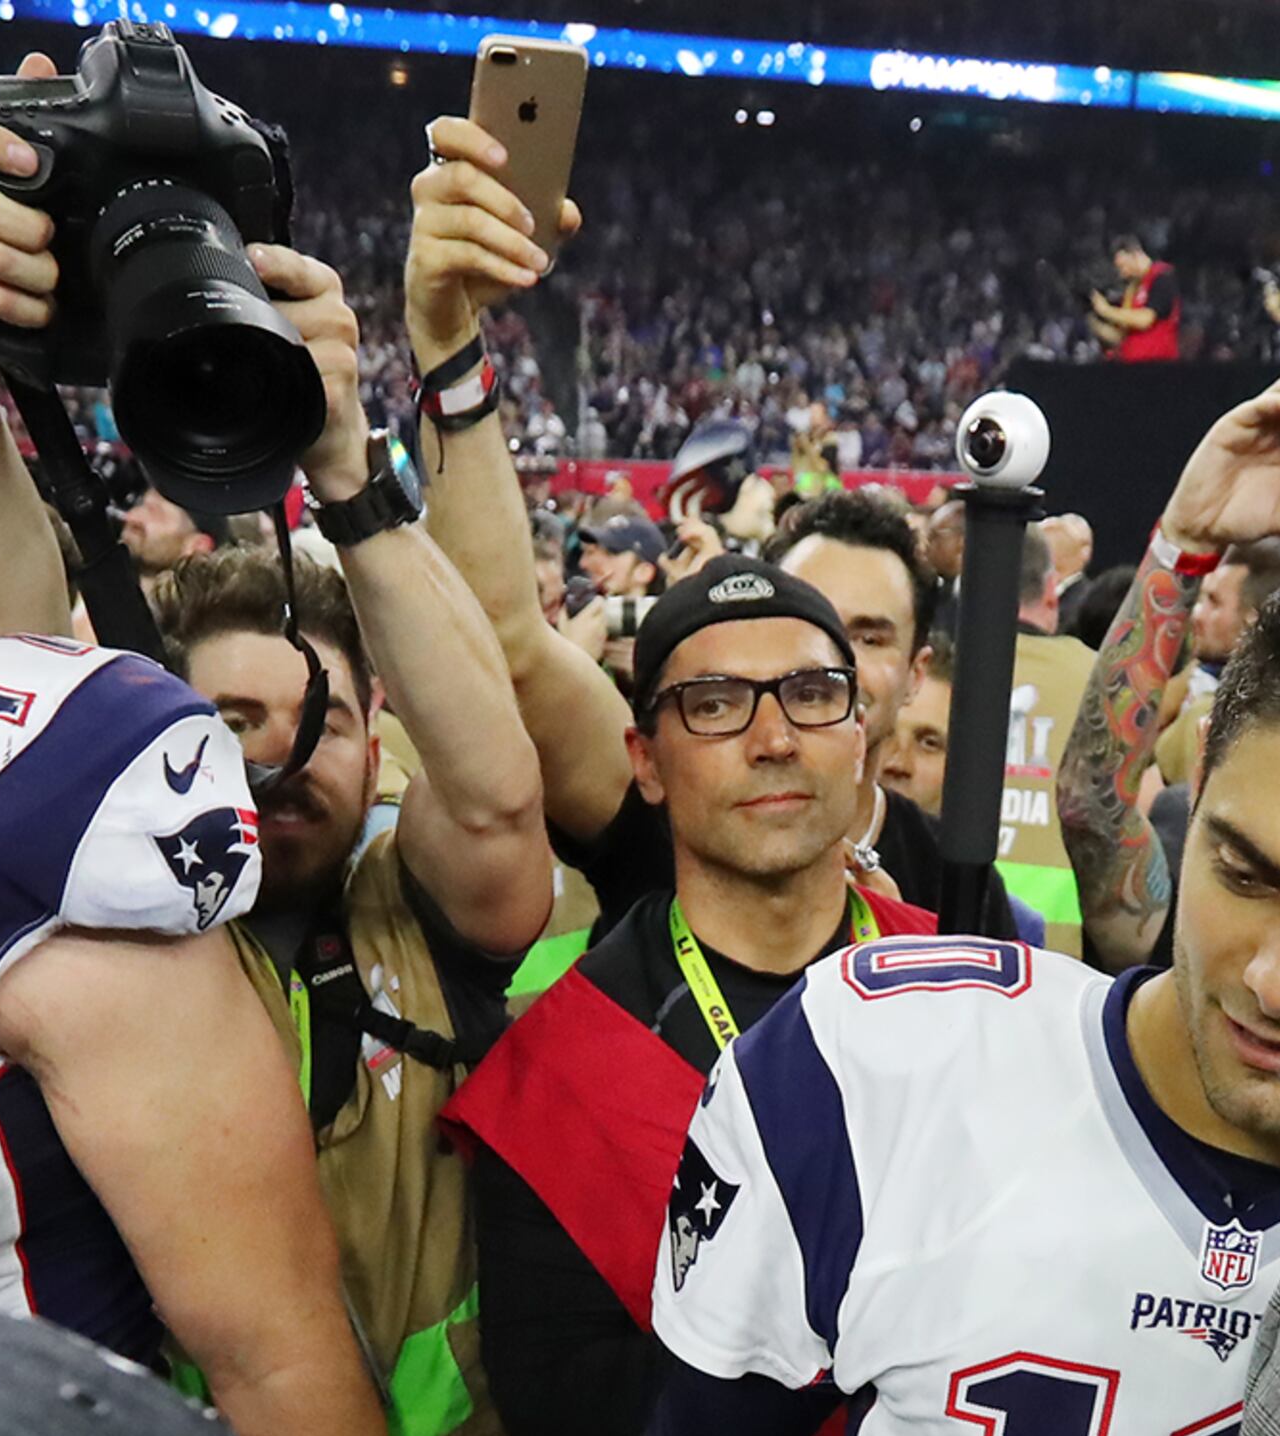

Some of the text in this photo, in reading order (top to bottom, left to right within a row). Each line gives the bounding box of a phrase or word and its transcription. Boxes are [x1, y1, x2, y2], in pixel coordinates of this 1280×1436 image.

[1000, 787, 1050, 826] DIA
[311, 963, 354, 986] Canon
[1207, 1250, 1249, 1284] NFL
